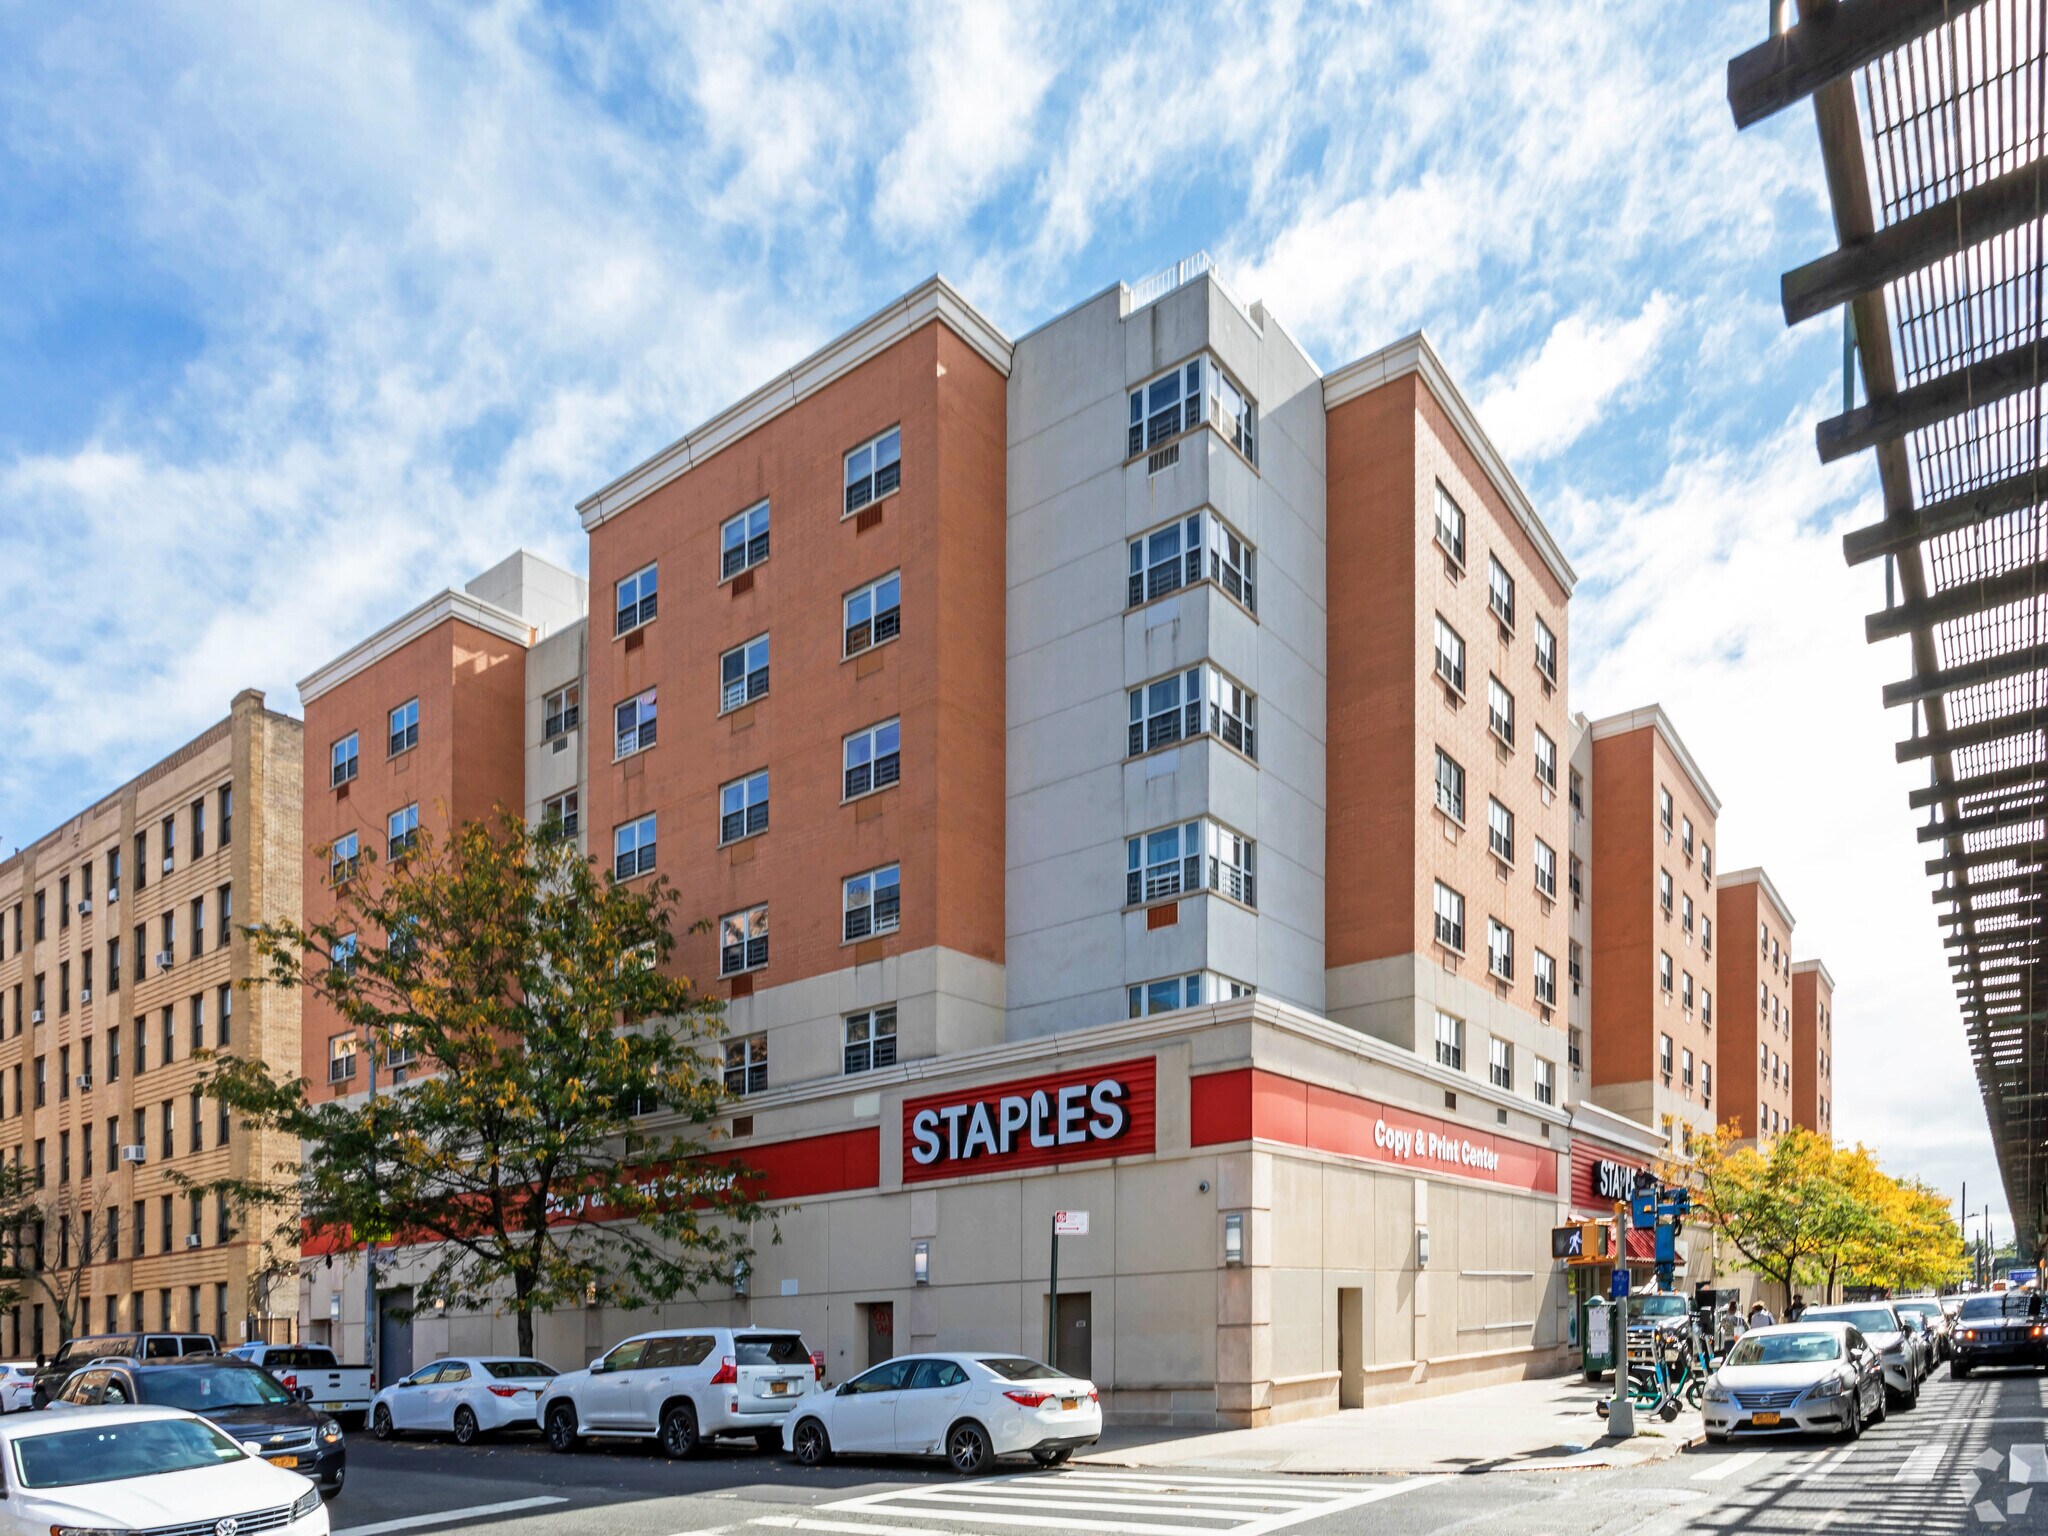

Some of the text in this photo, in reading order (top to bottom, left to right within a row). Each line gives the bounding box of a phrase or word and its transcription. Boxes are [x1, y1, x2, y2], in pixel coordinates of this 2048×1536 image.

[911, 1079, 1124, 1165] STAPLES
[1374, 1118, 1499, 1171] Copy & Print Center
